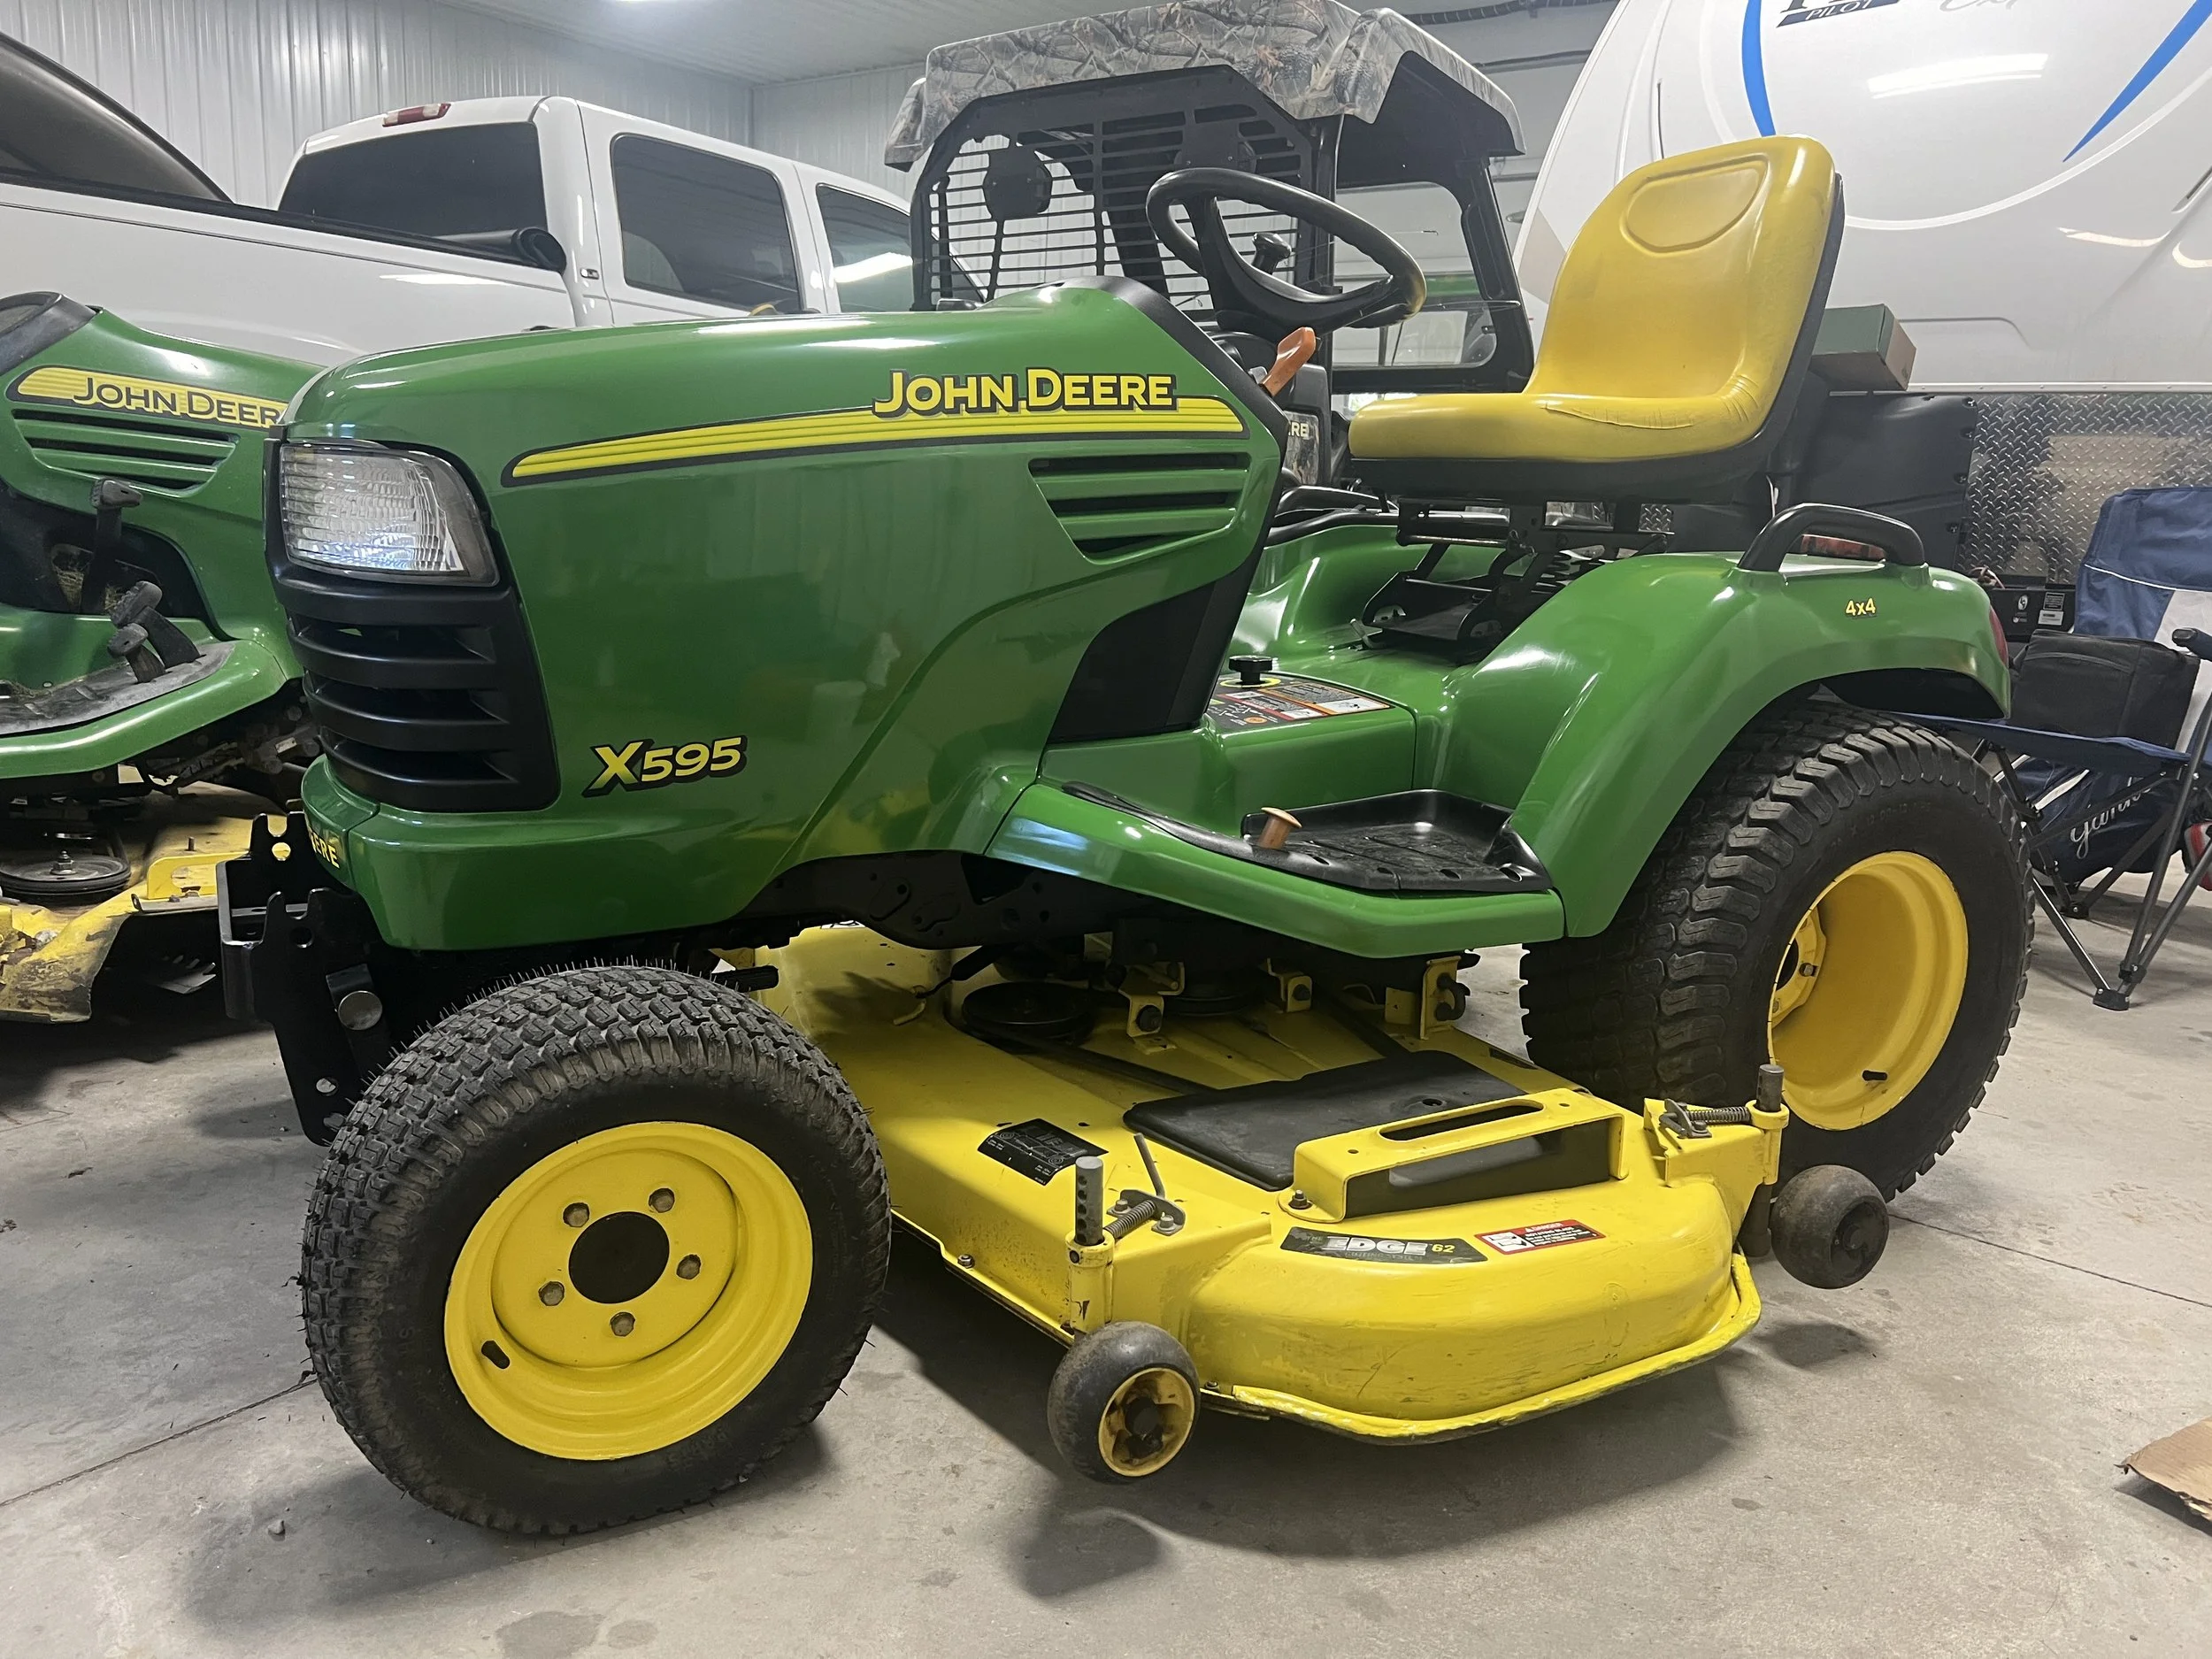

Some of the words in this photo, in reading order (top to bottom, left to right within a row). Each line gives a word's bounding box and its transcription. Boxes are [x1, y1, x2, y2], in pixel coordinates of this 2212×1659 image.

[73, 377, 176, 416] JOHN
[187, 390, 280, 425] DEER
[872, 370, 1017, 416] JOHN
[1025, 367, 1176, 410] DEERE
[1845, 597, 1876, 616] 4x4
[586, 736, 745, 794] X595
[311, 832, 340, 869] ERE
[1322, 1235, 1428, 1256] EDGE
[1432, 1243, 1455, 1253] 62
